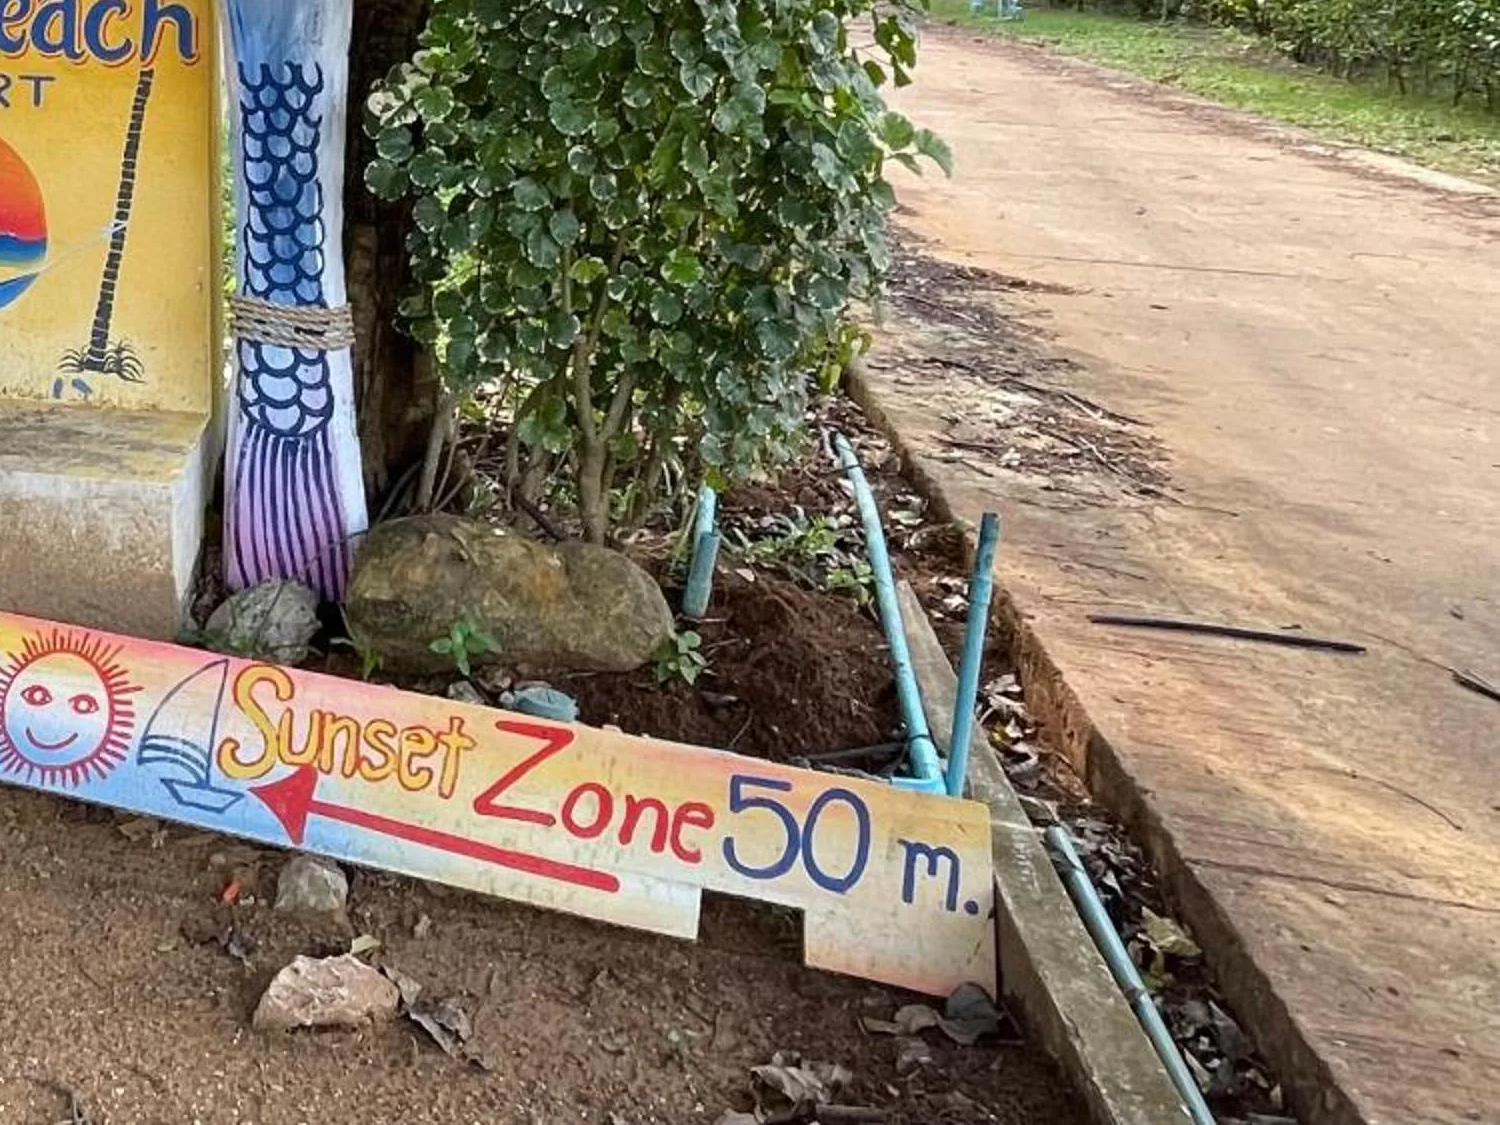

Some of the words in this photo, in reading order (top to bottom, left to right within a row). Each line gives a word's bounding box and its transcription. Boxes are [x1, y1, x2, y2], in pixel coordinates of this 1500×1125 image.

[216, 663, 477, 799] Sunset
[473, 720, 714, 865] Zone
[722, 774, 873, 895] 50
[899, 839, 980, 916] m.
